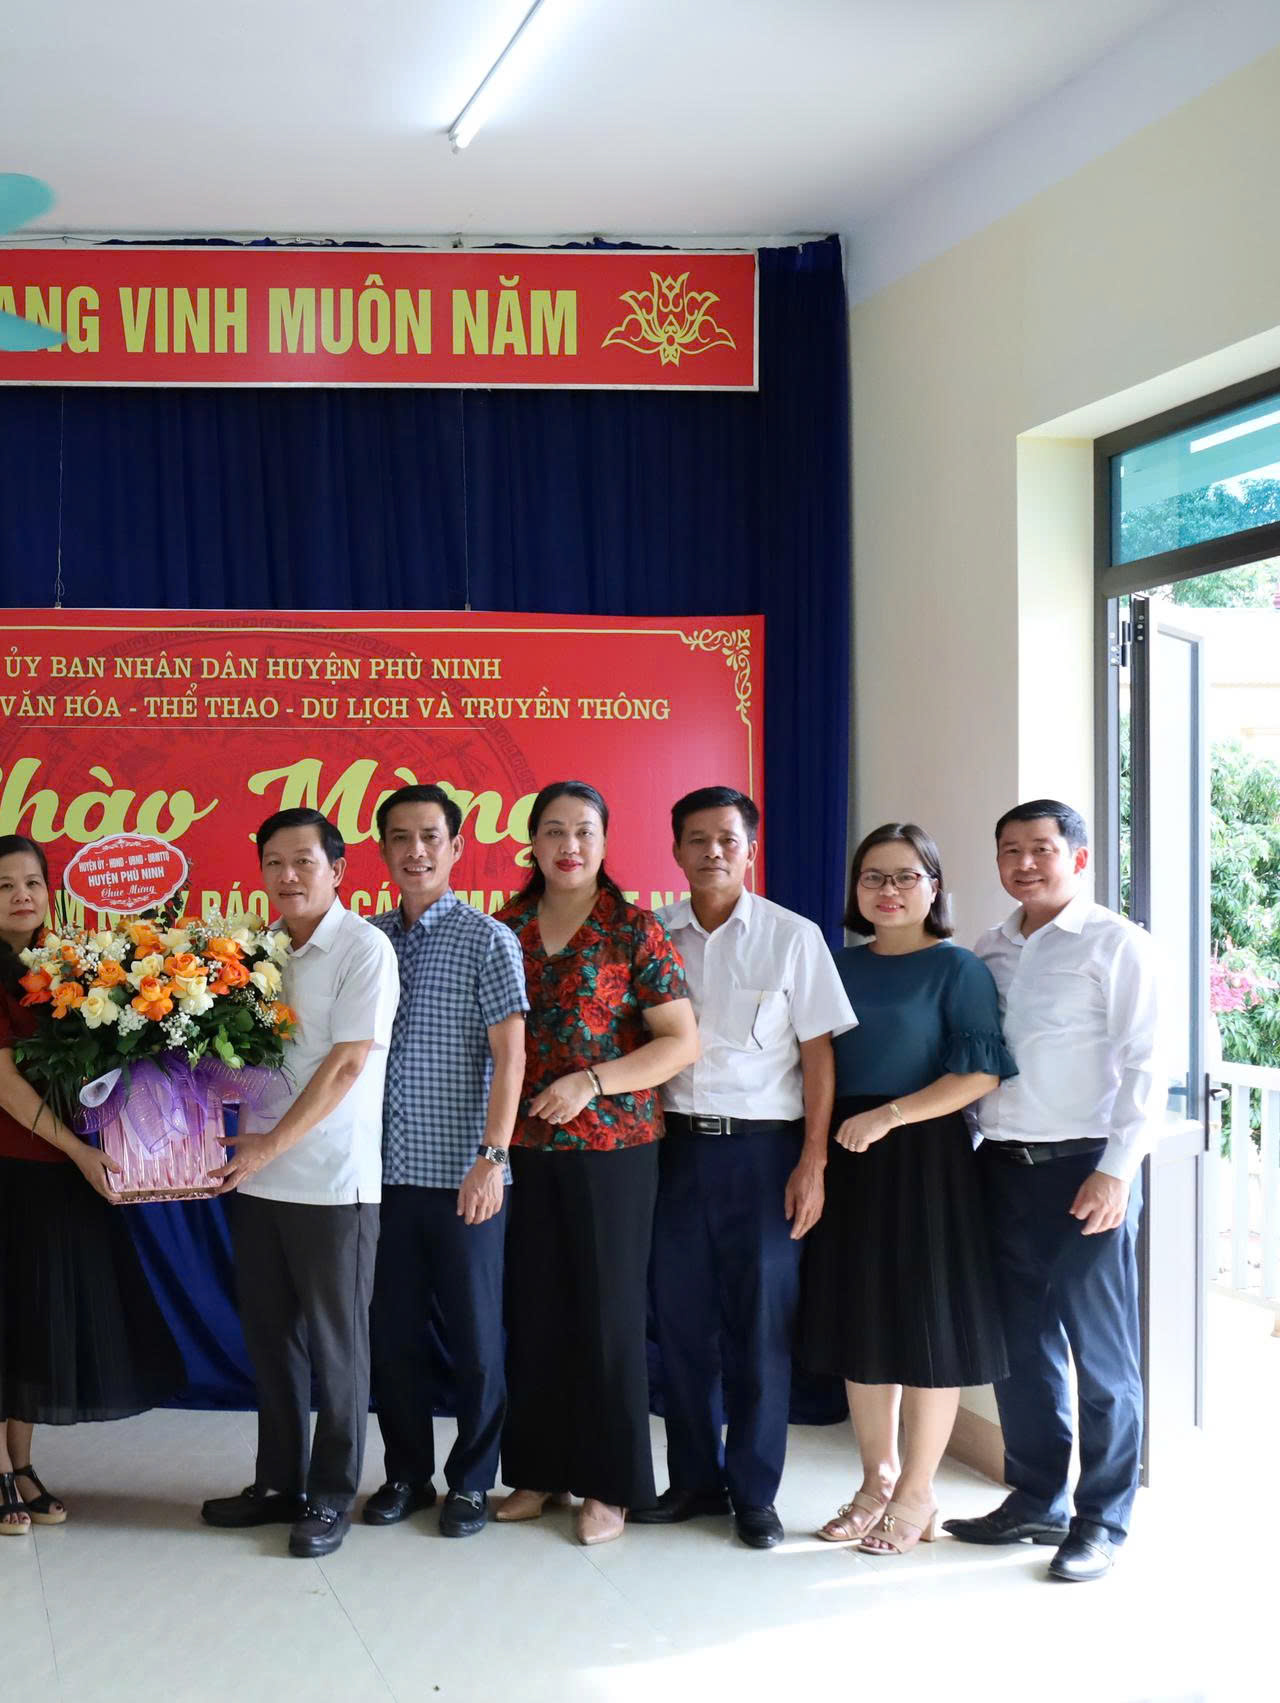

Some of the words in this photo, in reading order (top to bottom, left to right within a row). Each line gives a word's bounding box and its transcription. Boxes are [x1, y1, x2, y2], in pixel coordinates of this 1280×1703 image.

[119, 287, 248, 354] VINH
[269, 273, 432, 356] MUÔN
[453, 274, 578, 356] NĂM
[5, 646, 42, 678] ỦY
[51, 656, 106, 678] BAN
[114, 651, 192, 679] NHÂN
[201, 651, 259, 679] DÂN
[267, 652, 361, 686] HUYỆN
[369, 651, 424, 680] PHÙ
[431, 658, 502, 680] NINH
[0, 689, 57, 717] VĂN
[64, 690, 122, 718] HÓA
[144, 682, 198, 718] THỂ
[205, 697, 279, 719] THAO
[301, 697, 339, 719] DU
[346, 697, 410, 725] LỊCH
[417, 690, 455, 719] VÀ
[461, 687, 570, 719] TRUYỀN
[578, 691, 672, 720] THÔNG
[88, 871, 118, 887] HUYỆN
[120, 867, 139, 882] PHÙ
[141, 866, 165, 880] NINH
